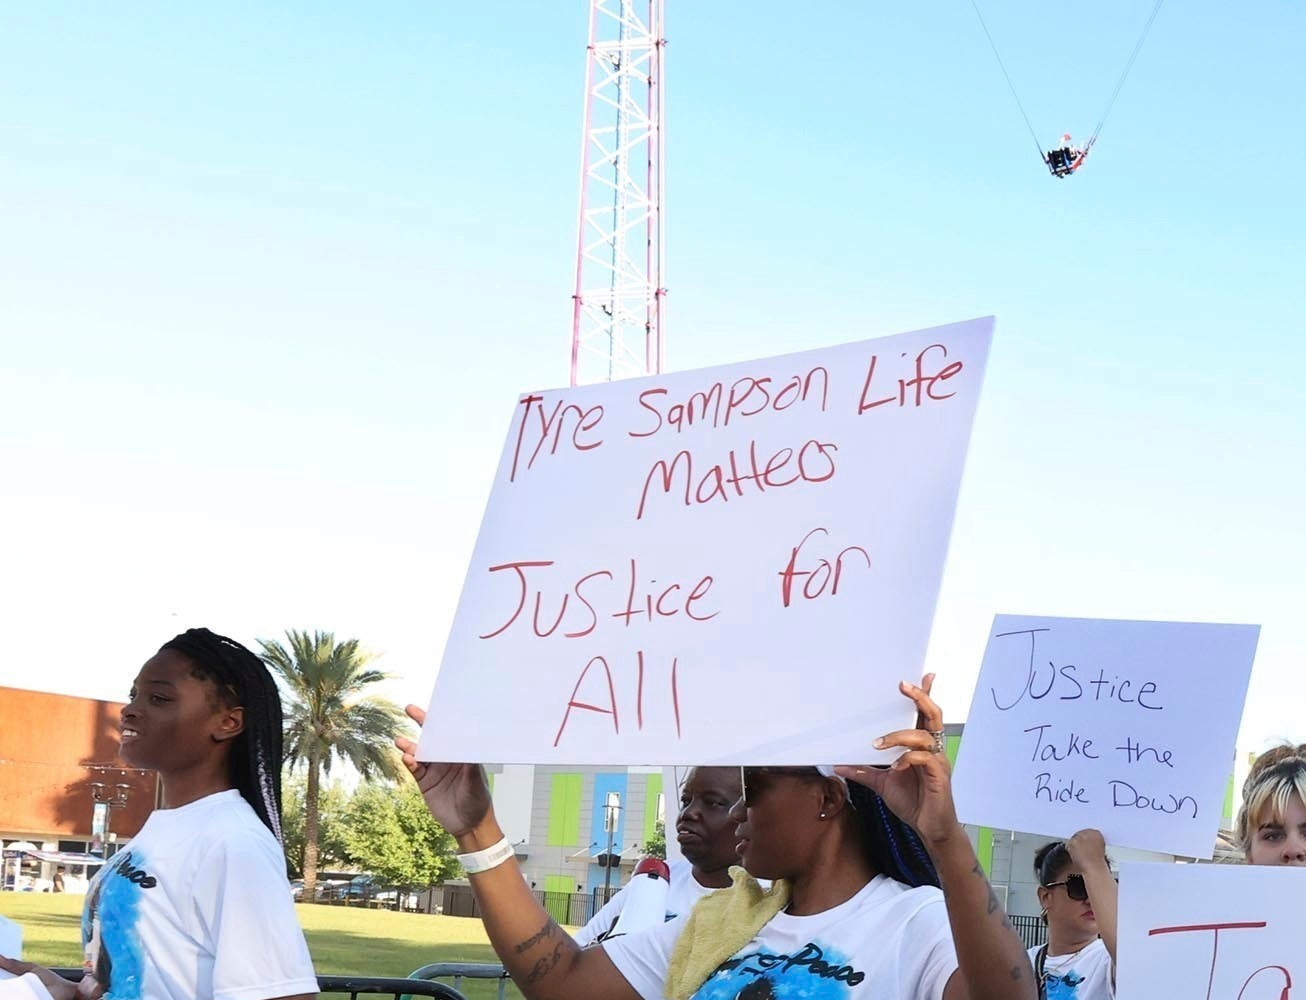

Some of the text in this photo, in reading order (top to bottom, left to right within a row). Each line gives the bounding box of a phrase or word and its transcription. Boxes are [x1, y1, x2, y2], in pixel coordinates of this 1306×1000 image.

[510, 343, 965, 483] Tyre Sampson Life
[478, 526, 872, 639] Justice for
[553, 650, 681, 747] All
[990, 628, 1164, 711] Justice
[1023, 724, 1175, 768] Take the
[1034, 772, 1199, 819] Ride Down
